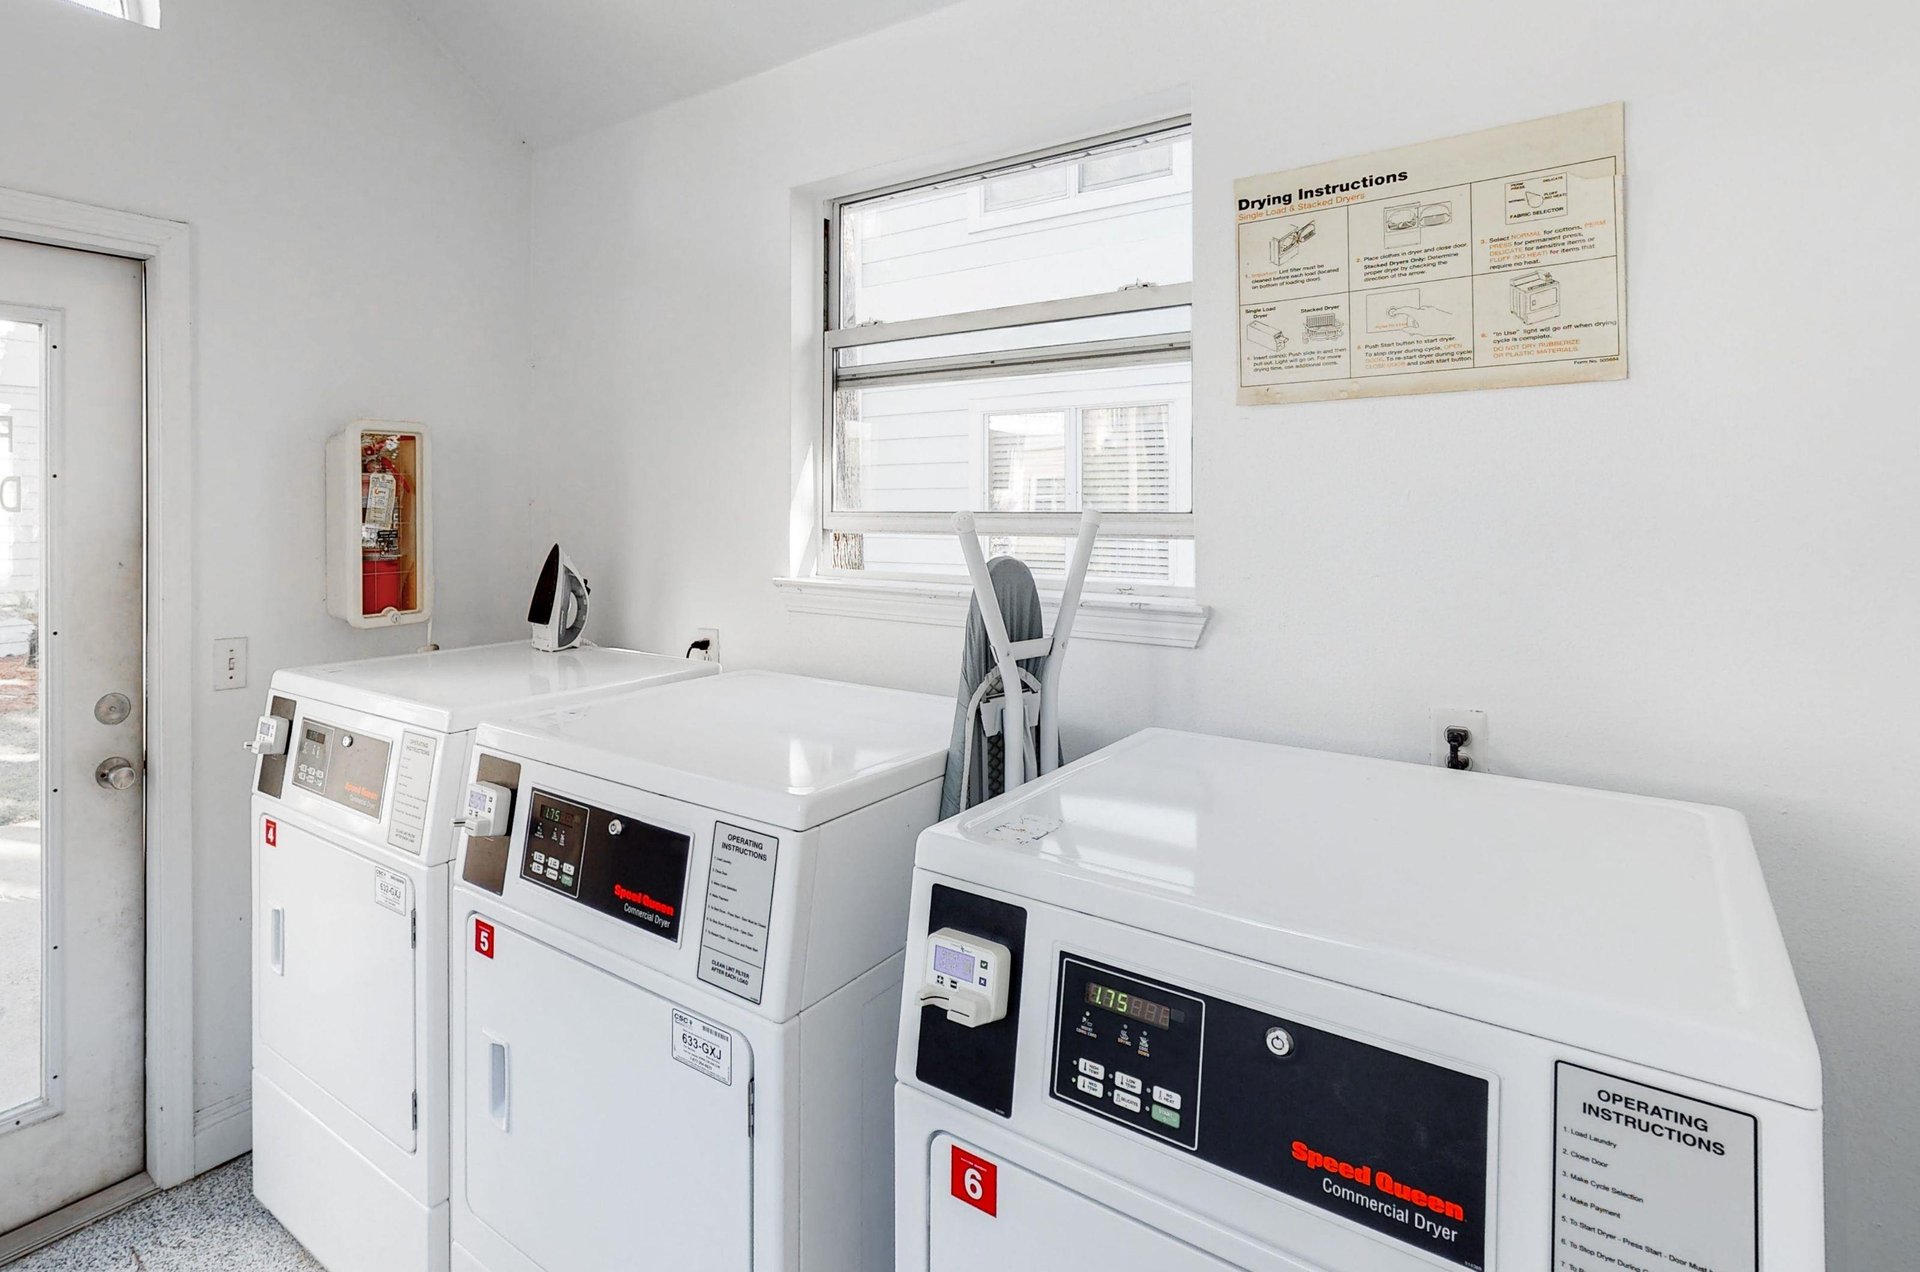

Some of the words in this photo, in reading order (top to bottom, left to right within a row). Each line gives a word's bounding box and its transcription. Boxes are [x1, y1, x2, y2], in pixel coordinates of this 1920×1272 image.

[1238, 193, 1292, 211] Drying
[1299, 171, 1408, 200] Instructions
[1239, 211, 1263, 221] Single
[1266, 207, 1287, 216] Load
[1298, 197, 1333, 211] Stacked
[1336, 193, 1365, 205] Dryers
[1533, 207, 1564, 216] SELECTOR
[1512, 231, 1541, 240] NORMAL
[1525, 234, 1561, 245] permanent
[1490, 247, 1523, 256] DELICATE
[1536, 241, 1565, 250] sensitive
[1364, 261, 1388, 269] Stacked
[1428, 252, 1459, 260] Determine
[1409, 262, 1436, 270] checking
[1538, 339, 1580, 348] RUBBERIZE
[268, 829, 274, 843] 4
[728, 833, 763, 850] OPERATING
[722, 842, 767, 862] INSTRUCTIONS
[614, 884, 642, 905] Speed
[643, 893, 674, 916] Queen
[624, 903, 654, 923] Commercial
[655, 914, 670, 929] Dryer
[480, 932, 489, 951] 5
[711, 966, 724, 976] AFTER
[725, 971, 736, 981] EACH
[737, 976, 749, 986] LOAD
[712, 959, 724, 969] CLEAN
[725, 965, 735, 973] LINT
[735, 968, 750, 979] FILTER
[1095, 986, 1128, 1012] 1.75
[674, 1013, 688, 1024] CSC
[682, 1033, 721, 1060] 633-GXJ
[1597, 1089, 1709, 1132] OPERATING
[1571, 1129, 1587, 1139] Load
[1589, 1133, 1617, 1149] Laundry
[1583, 1102, 1726, 1156] INSTRUCTIONS
[1570, 1151, 1590, 1163] Close
[1591, 1157, 1608, 1168] Door
[964, 1168, 983, 1200] 6
[1291, 1140, 1371, 1186] Speed
[1375, 1171, 1464, 1221] Queen
[1570, 1172, 1589, 1184] Make
[1590, 1180, 1610, 1192] Cycle
[1612, 1187, 1644, 1203] Selection
[1323, 1177, 1409, 1224] Commercial
[1414, 1212, 1458, 1242] Dryer
[1570, 1195, 1589, 1207] Make
[1590, 1203, 1621, 1218] Payment
[1561, 1215, 1568, 1223] 5.
[1570, 1218, 1578, 1226] To
[1579, 1222, 1596, 1233] Start
[1597, 1228, 1617, 1241] Dryer
[1623, 1238, 1643, 1251] Press
[1645, 1245, 1662, 1257] Start
[1669, 1253, 1687, 1265] Door
[1570, 1241, 1577, 1250] To
[1579, 1245, 1595, 1256] Stop
[1597, 1251, 1615, 1263] Dryer
[1617, 1260, 1640, 1272] During
[1569, 1264, 1577, 1272] To
